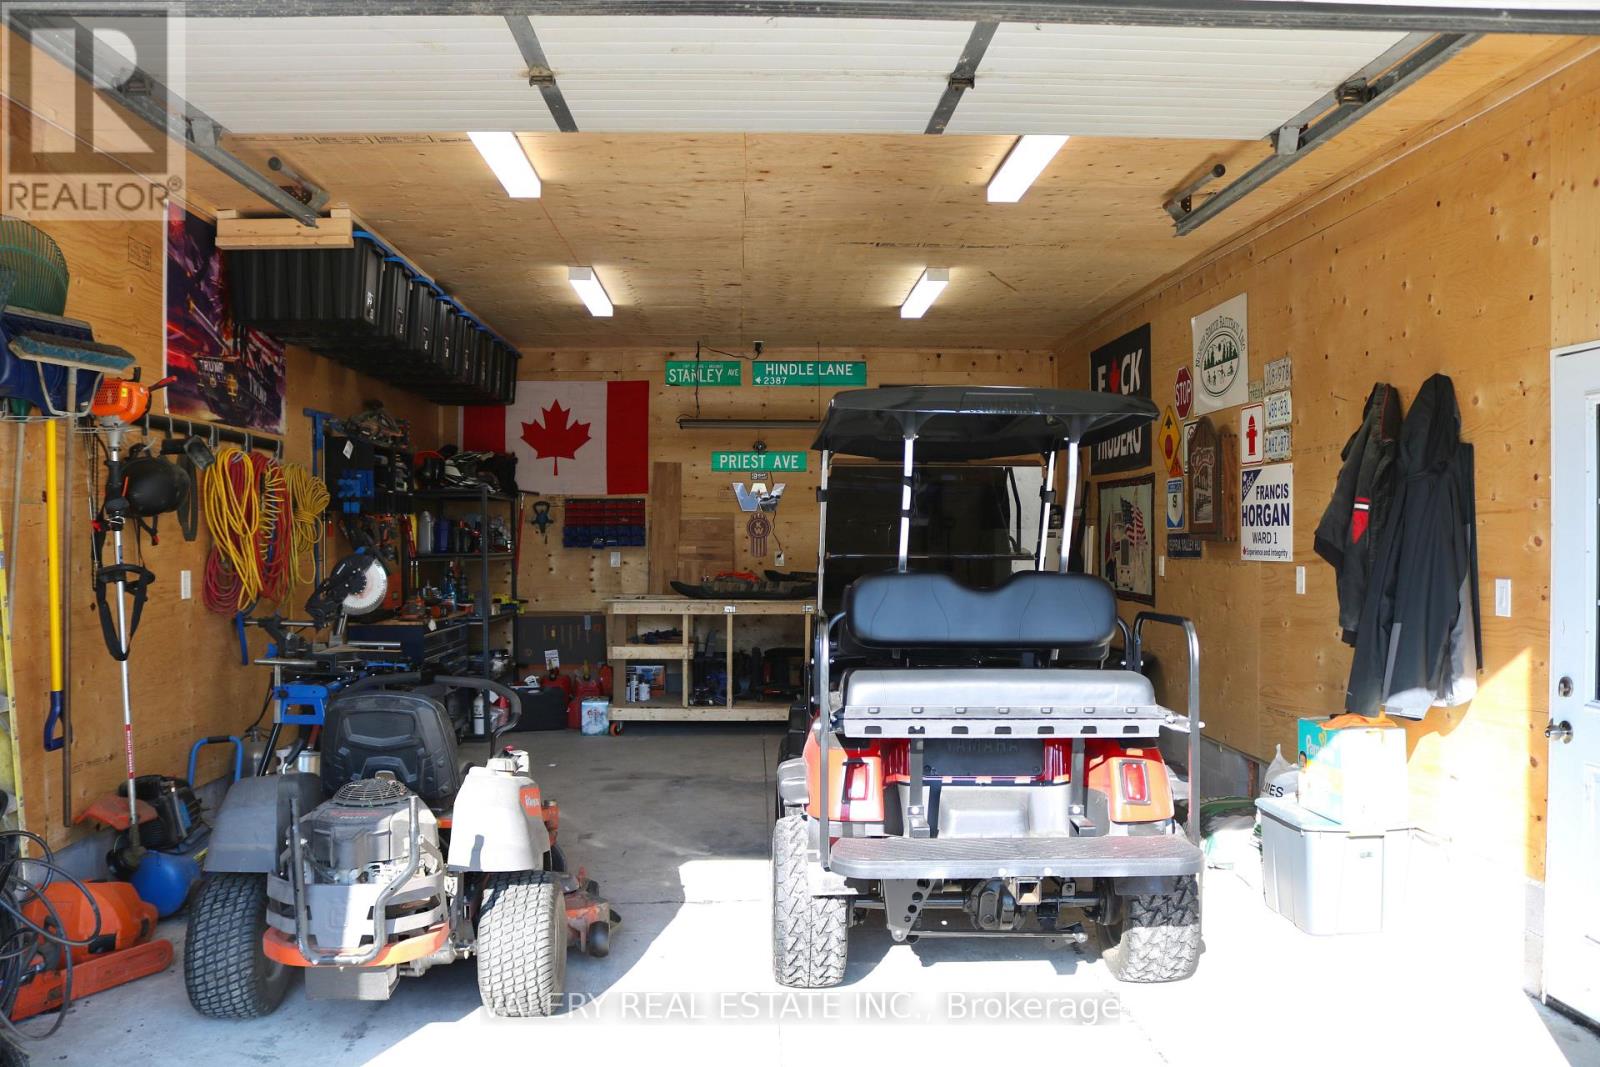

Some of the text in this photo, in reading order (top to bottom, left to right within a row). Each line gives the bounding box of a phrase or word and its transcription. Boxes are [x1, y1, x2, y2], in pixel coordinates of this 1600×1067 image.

[765, 364, 853, 376] HINDLE LANE
[1176, 379, 1191, 406] STOP
[720, 455, 799, 469] PRIEST AVE
[1255, 483, 1289, 500] FRANCIS
[1242, 503, 1290, 527] HORGAN
[1252, 532, 1278, 544] WARD 1
